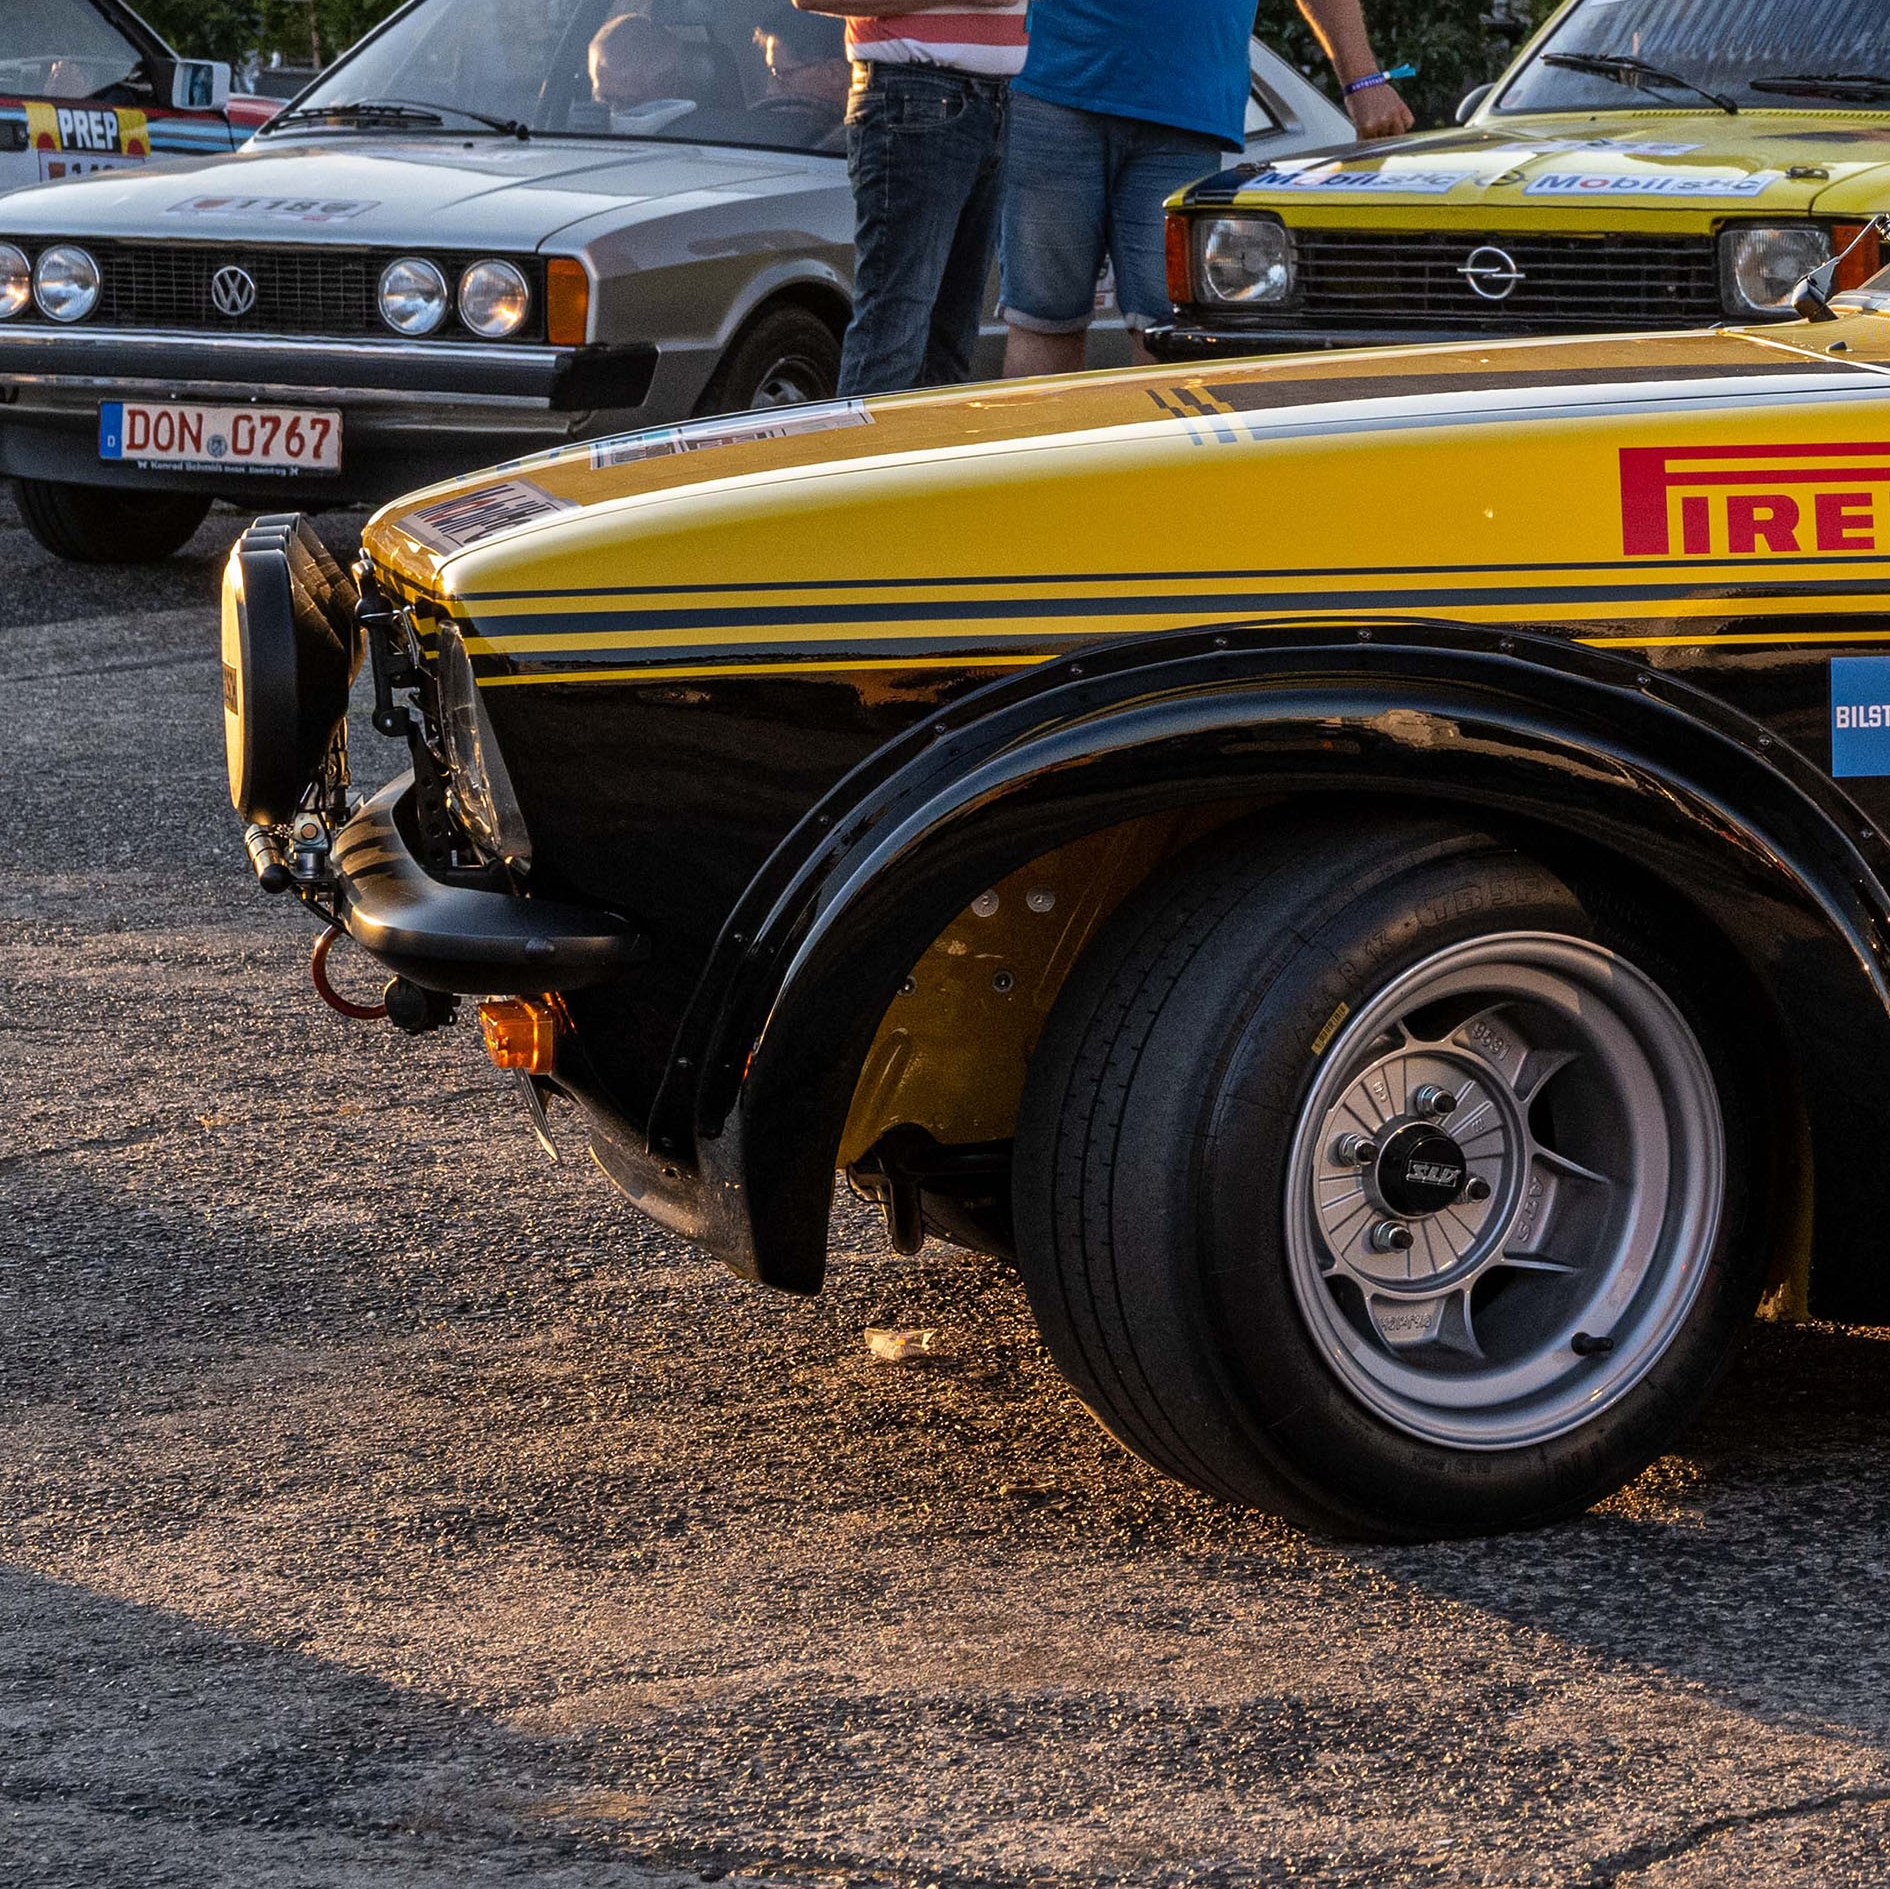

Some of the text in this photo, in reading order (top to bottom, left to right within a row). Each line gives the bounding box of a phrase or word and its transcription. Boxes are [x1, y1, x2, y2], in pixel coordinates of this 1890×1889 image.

[56, 108, 119, 151] PREP
[1254, 172, 1379, 187] Mobil
[1535, 174, 1674, 192] Mobil
[126, 409, 203, 453] DON
[231, 414, 332, 460] 0767
